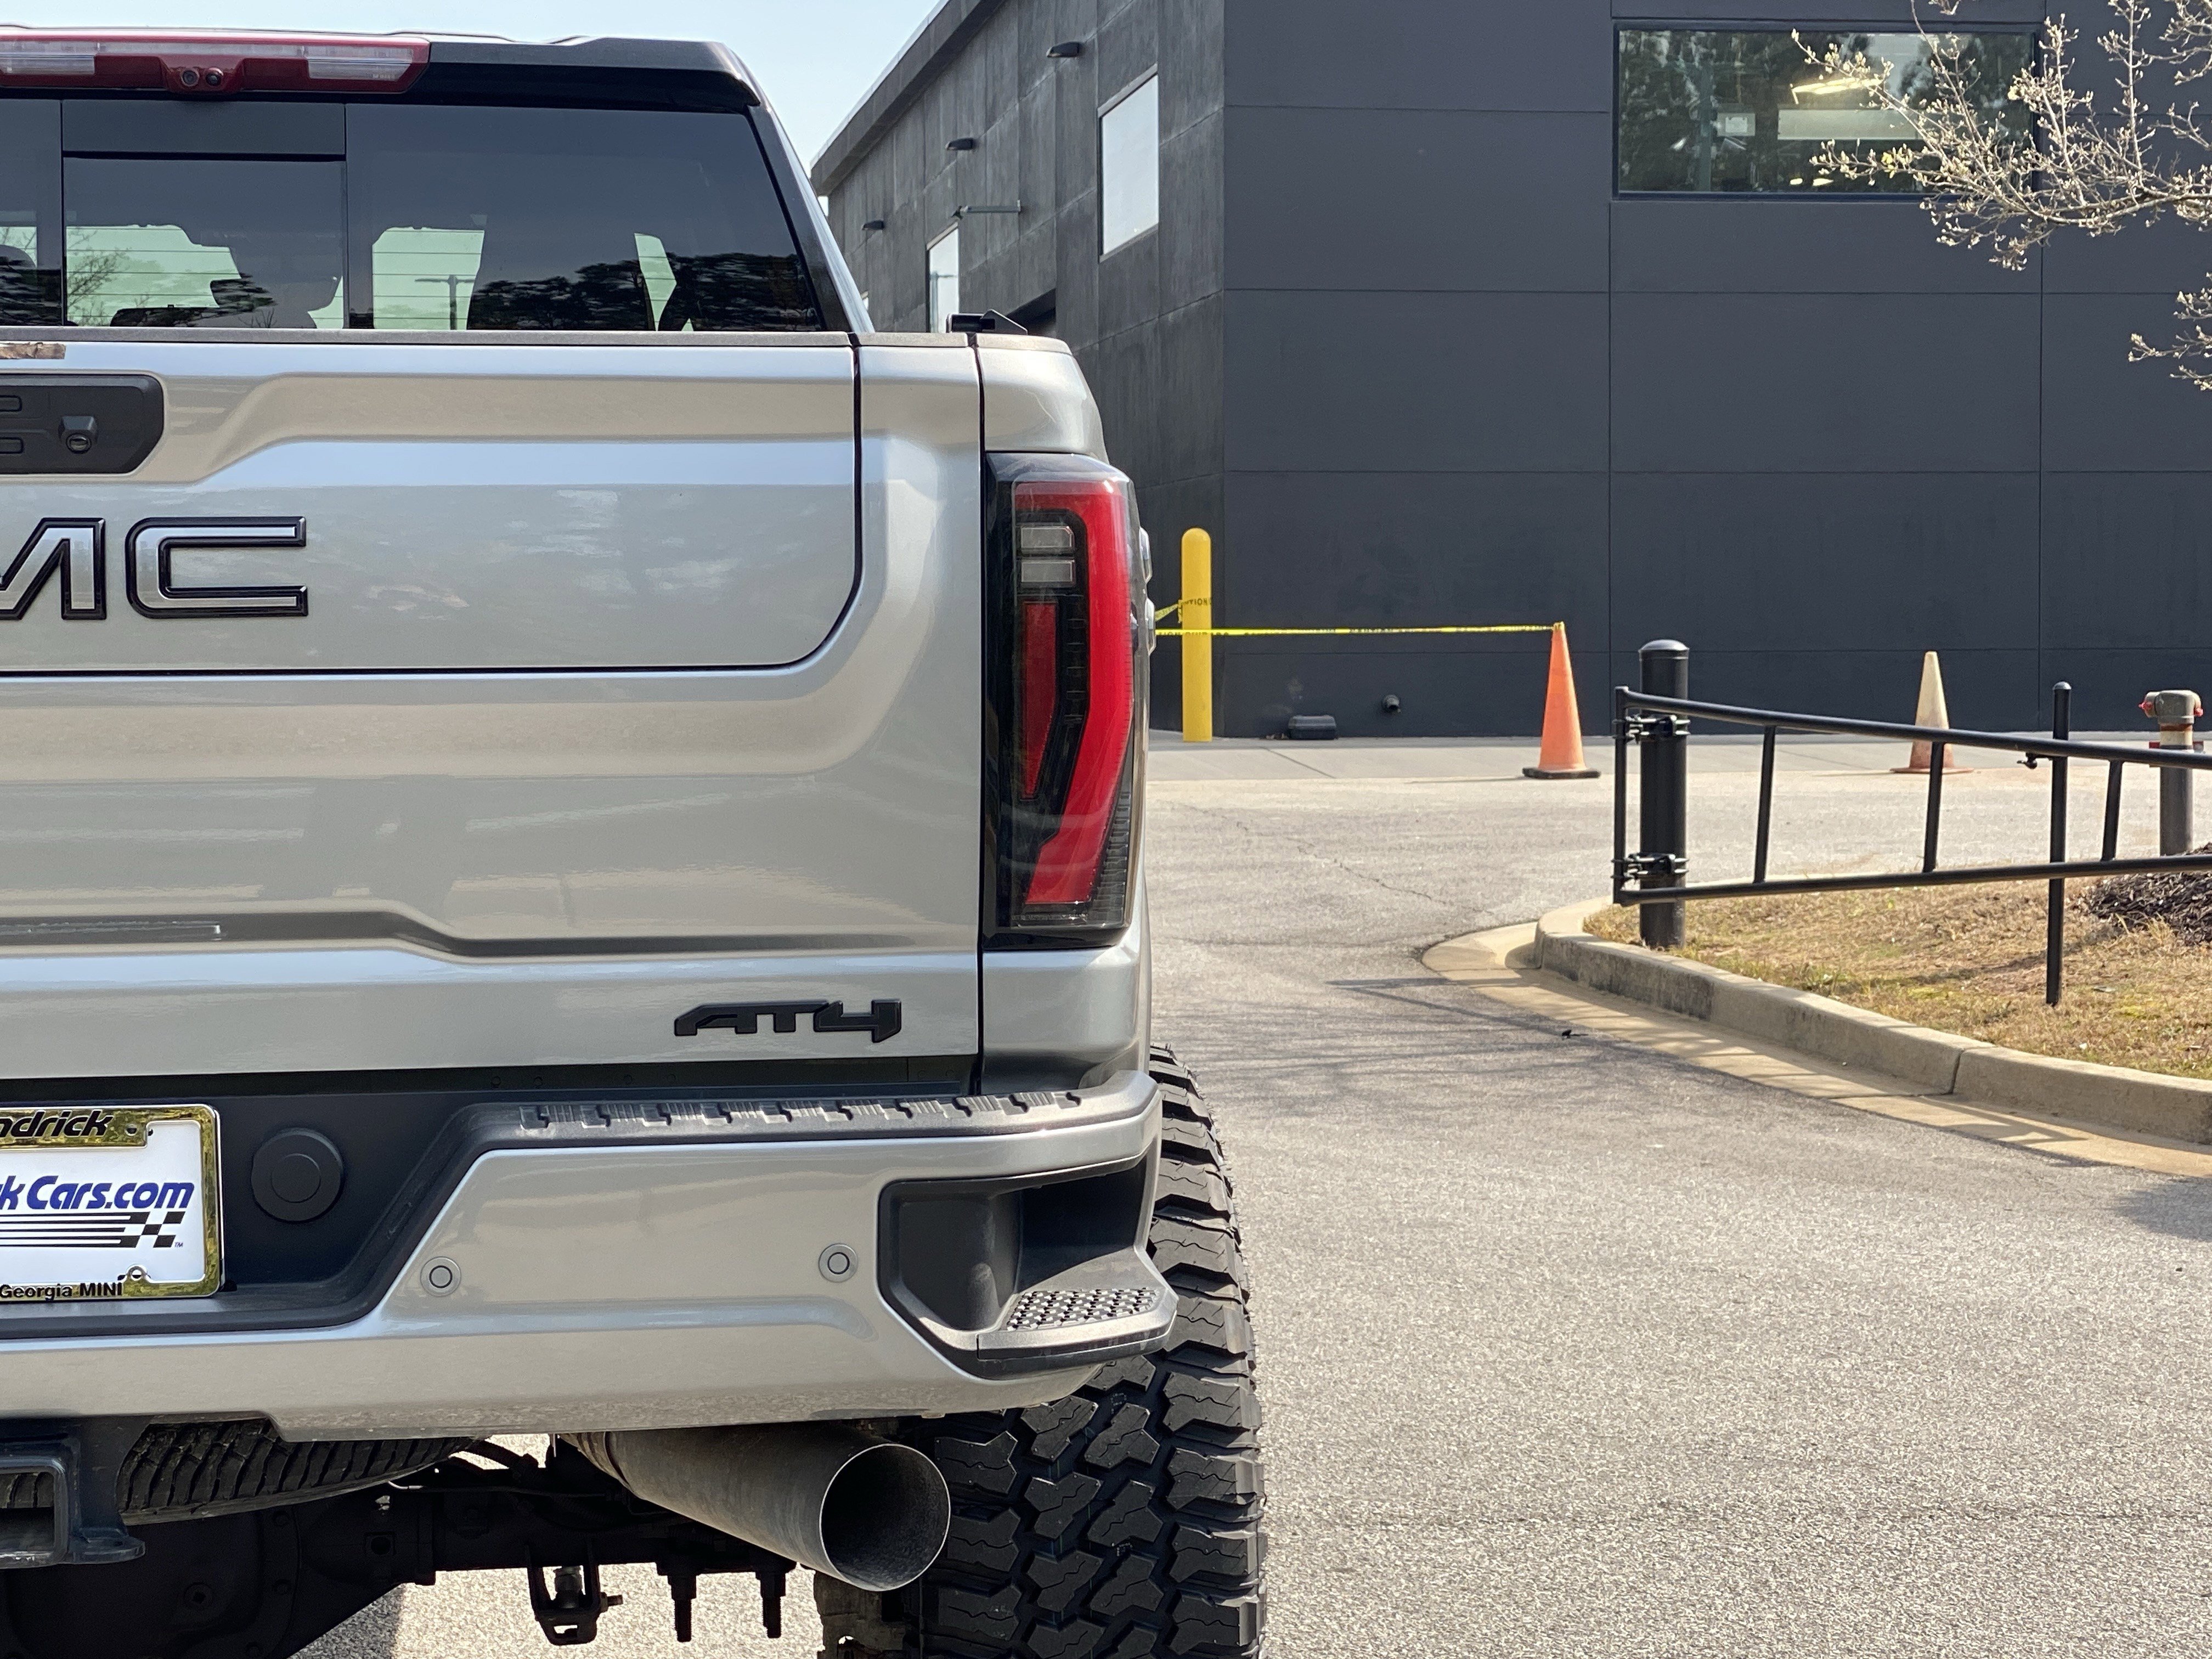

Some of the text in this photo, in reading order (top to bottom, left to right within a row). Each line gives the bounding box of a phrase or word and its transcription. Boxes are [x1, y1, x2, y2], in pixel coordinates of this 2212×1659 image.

[674, 999, 901, 1043] AT4
[0, 1175, 195, 1210] kCars.com
[0, 1282, 122, 1302] Georgia MINI
